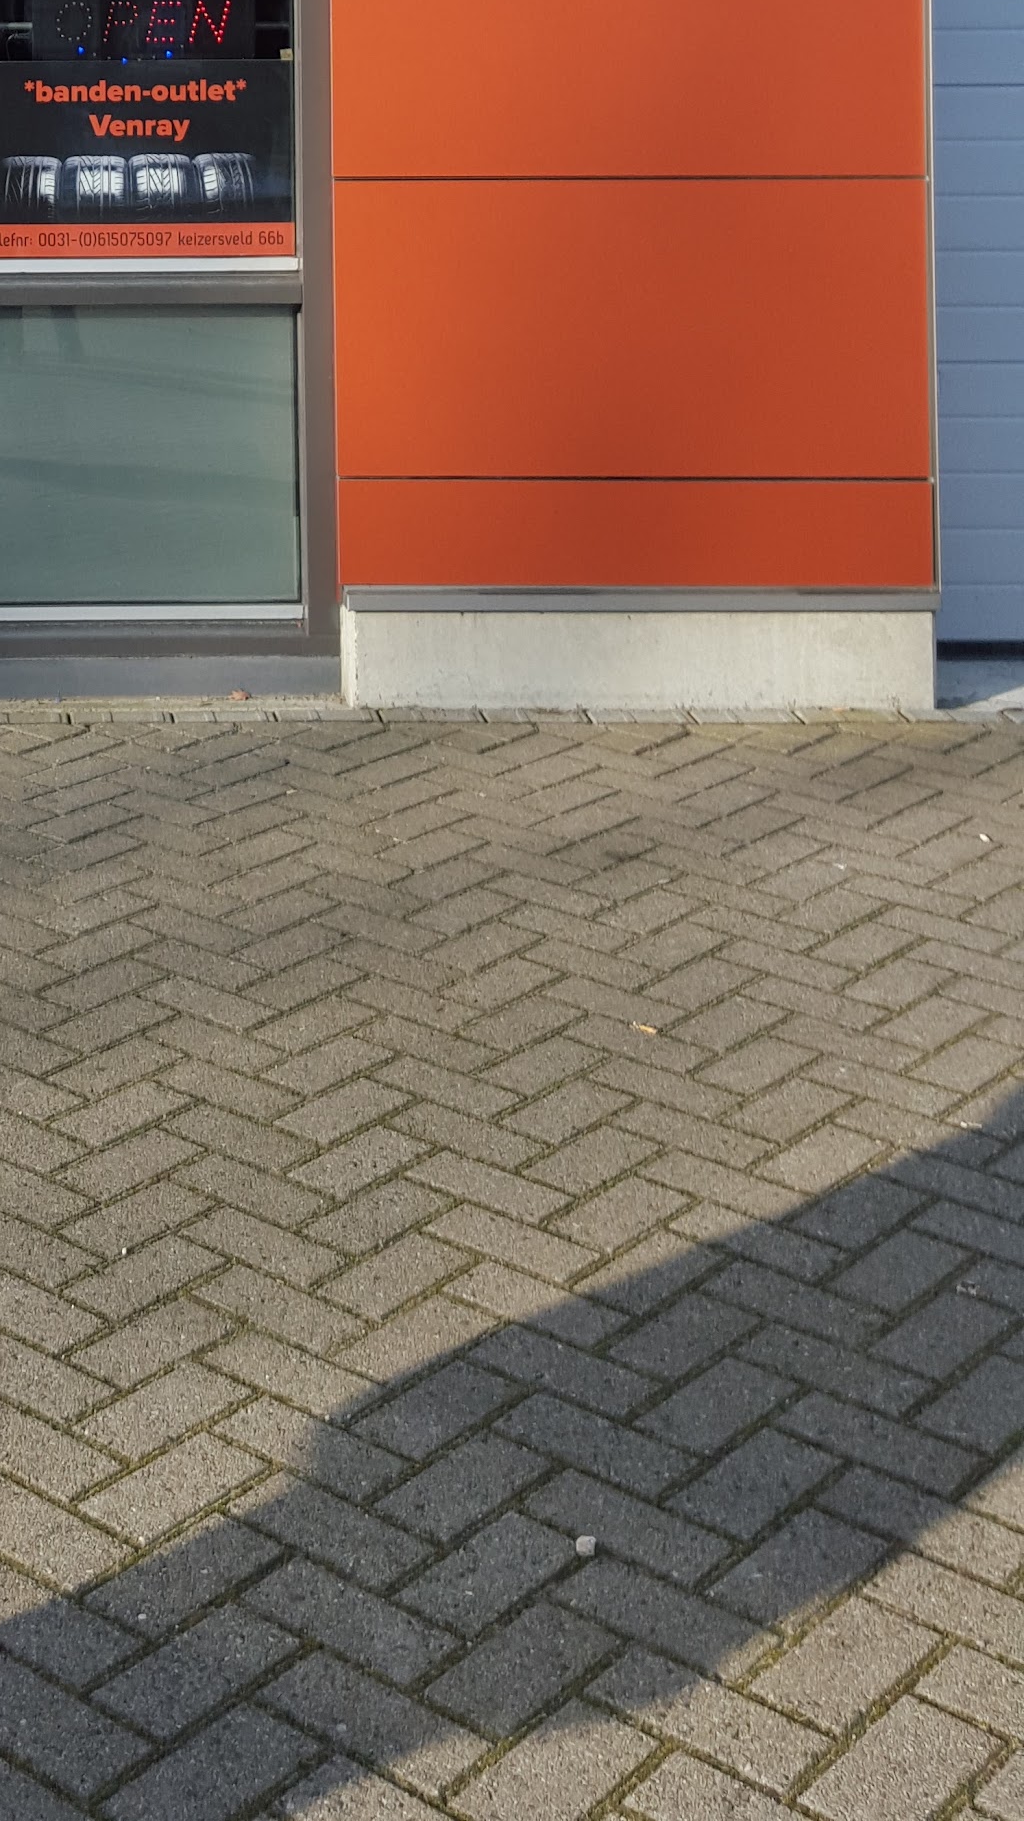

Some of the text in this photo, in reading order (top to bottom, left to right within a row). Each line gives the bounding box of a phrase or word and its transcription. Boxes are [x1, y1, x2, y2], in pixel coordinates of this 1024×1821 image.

[56, 0, 232, 44] OPEN
[88, 114, 190, 142] Venray
[38, 231, 172, 248] 0031-(0)615075097
[178, 231, 253, 247] keizersveld
[258, 230, 284, 246] 66b
